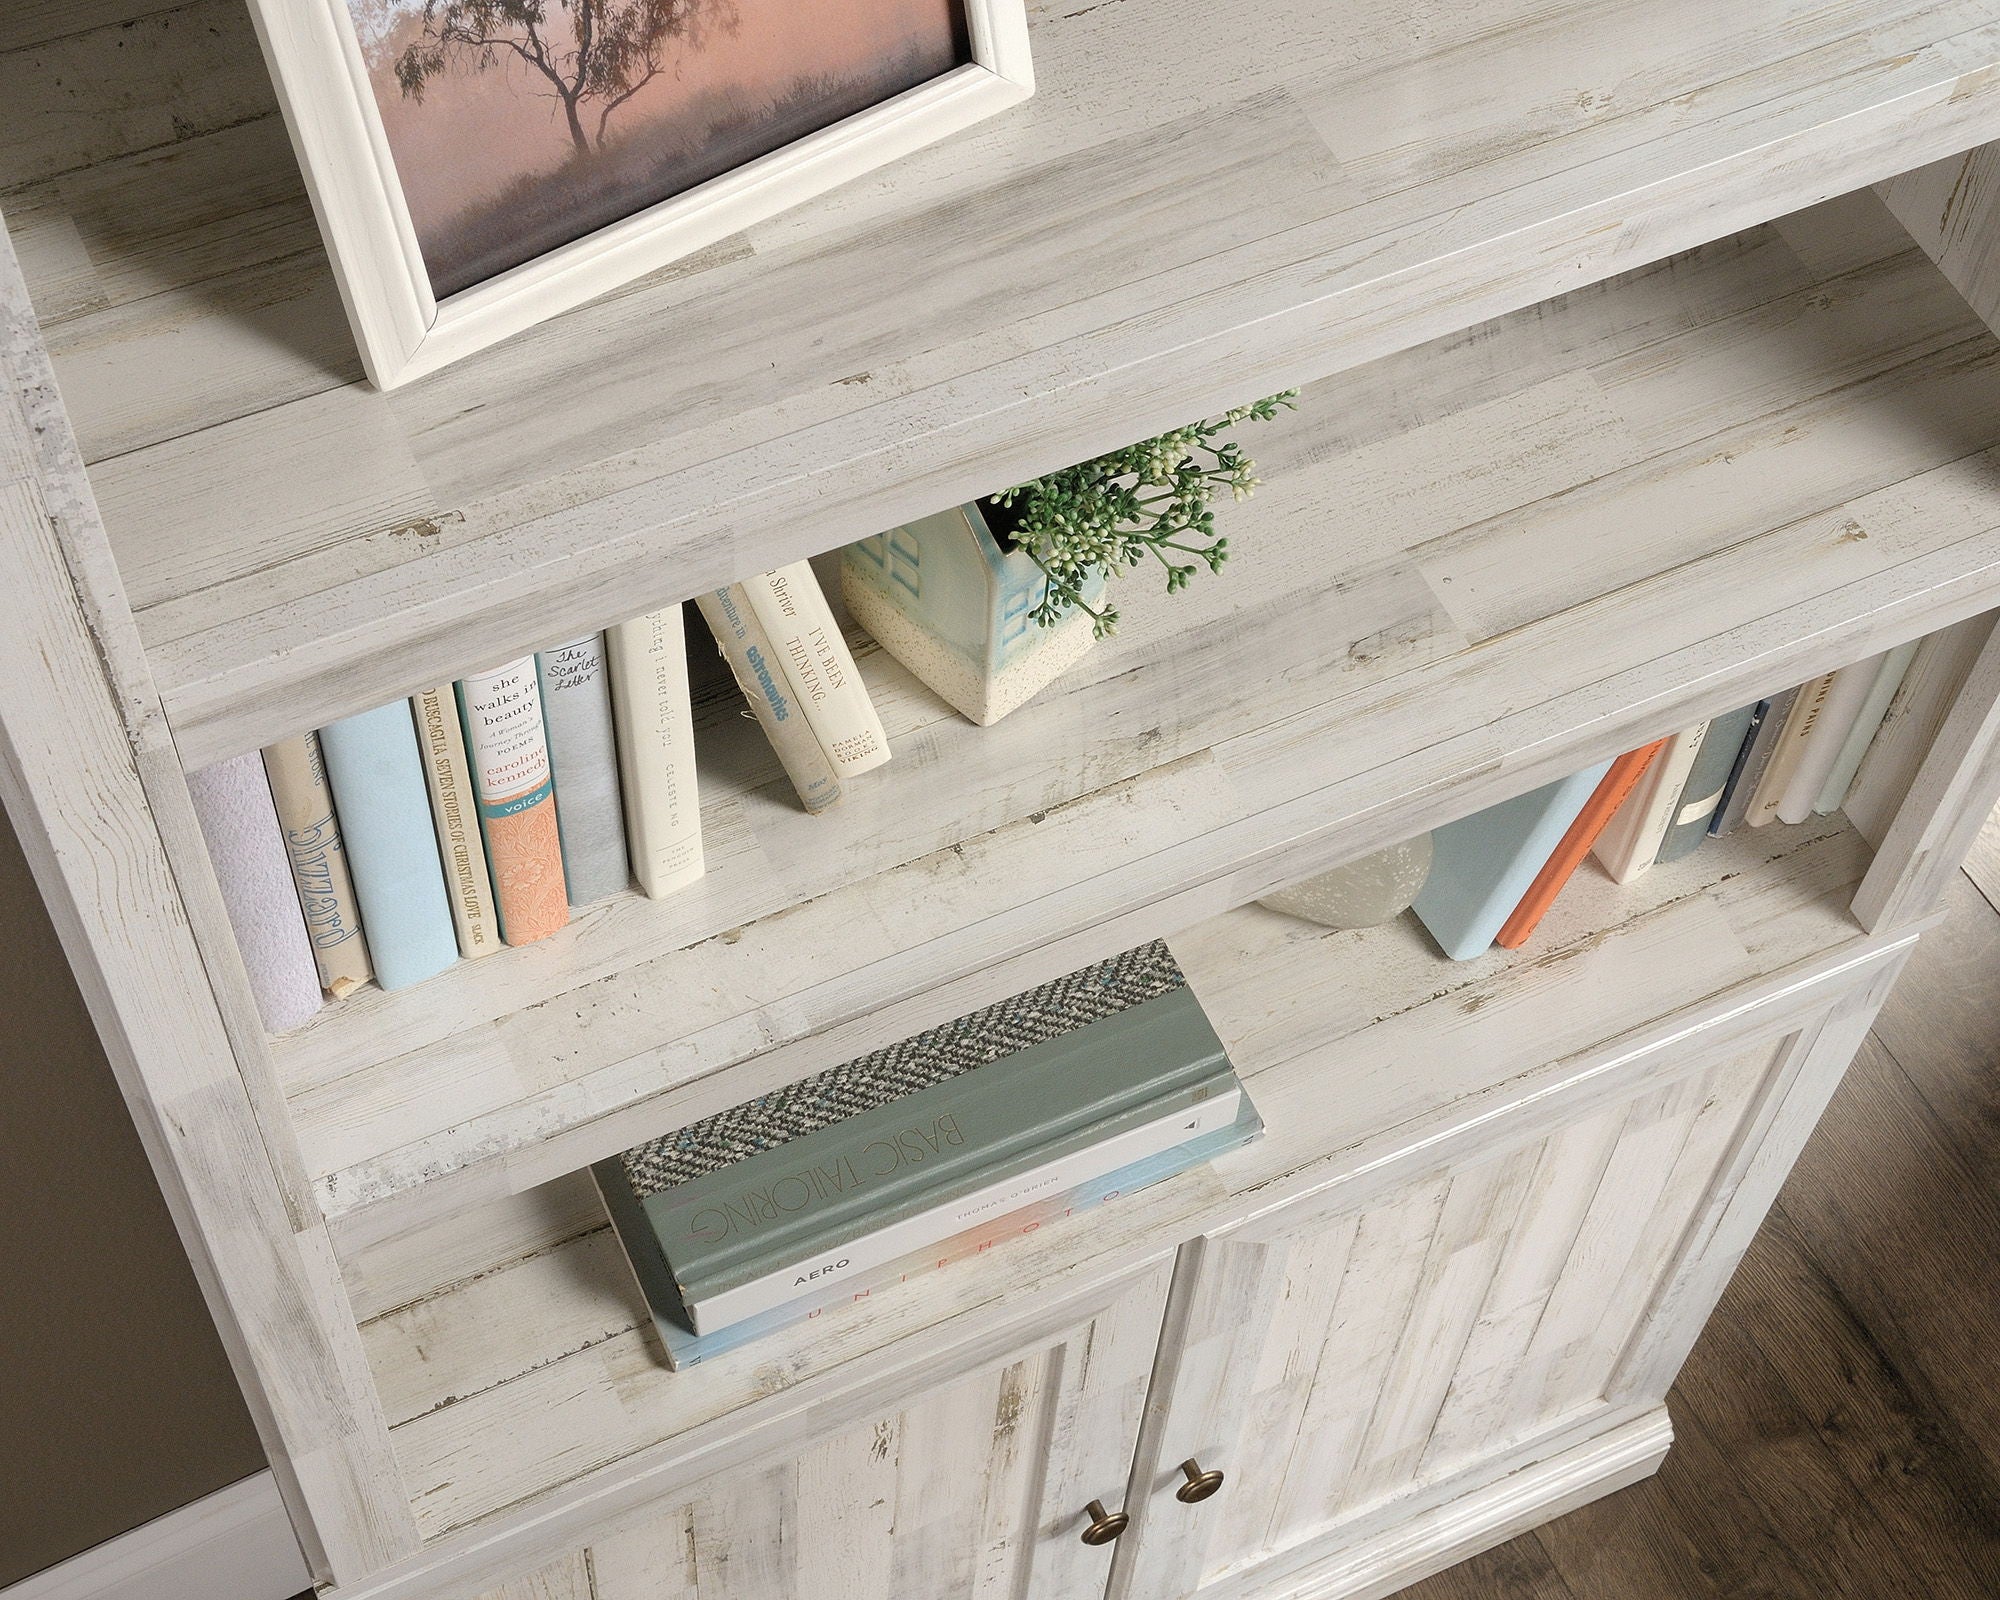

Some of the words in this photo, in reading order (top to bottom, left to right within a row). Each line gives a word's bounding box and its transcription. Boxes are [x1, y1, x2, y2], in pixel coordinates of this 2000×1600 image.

[769, 576, 797, 619] Shriver
[548, 655, 601, 677] Scarlet
[556, 650, 587, 662] The
[808, 627, 830, 656] I'VE
[822, 656, 846, 690] BEEN
[492, 675, 520, 692] she
[555, 669, 598, 691] Letter
[655, 666, 668, 697] never
[735, 625, 746, 639] in
[745, 645, 788, 722] astronautics
[473, 691, 520, 712] walks
[524, 680, 537, 694] in
[659, 699, 674, 724] told
[484, 698, 535, 726] beauty
[497, 737, 534, 757] POEMS
[656, 729, 672, 748] you
[487, 745, 545, 776] caroline
[840, 746, 878, 764] VIKING
[436, 758, 455, 791] SEVEN
[487, 757, 547, 787] kennedy
[664, 763, 678, 808] CELESTE
[442, 790, 463, 829] STORIES
[505, 792, 544, 813] voice
[451, 829, 464, 843] OF
[289, 811, 360, 949] blizzard
[454, 844, 475, 895] CHRISTMAS
[465, 895, 481, 919] LOVE
[863, 1113, 965, 1176] BASIC
[690, 1155, 866, 1243] TAILORING
[956, 1200, 1006, 1220] THOMAS
[1010, 1176, 1059, 1199] O'BRIEN
[808, 1190, 1120, 1321] UNIPHOTO
[793, 1259, 850, 1286] AERO
